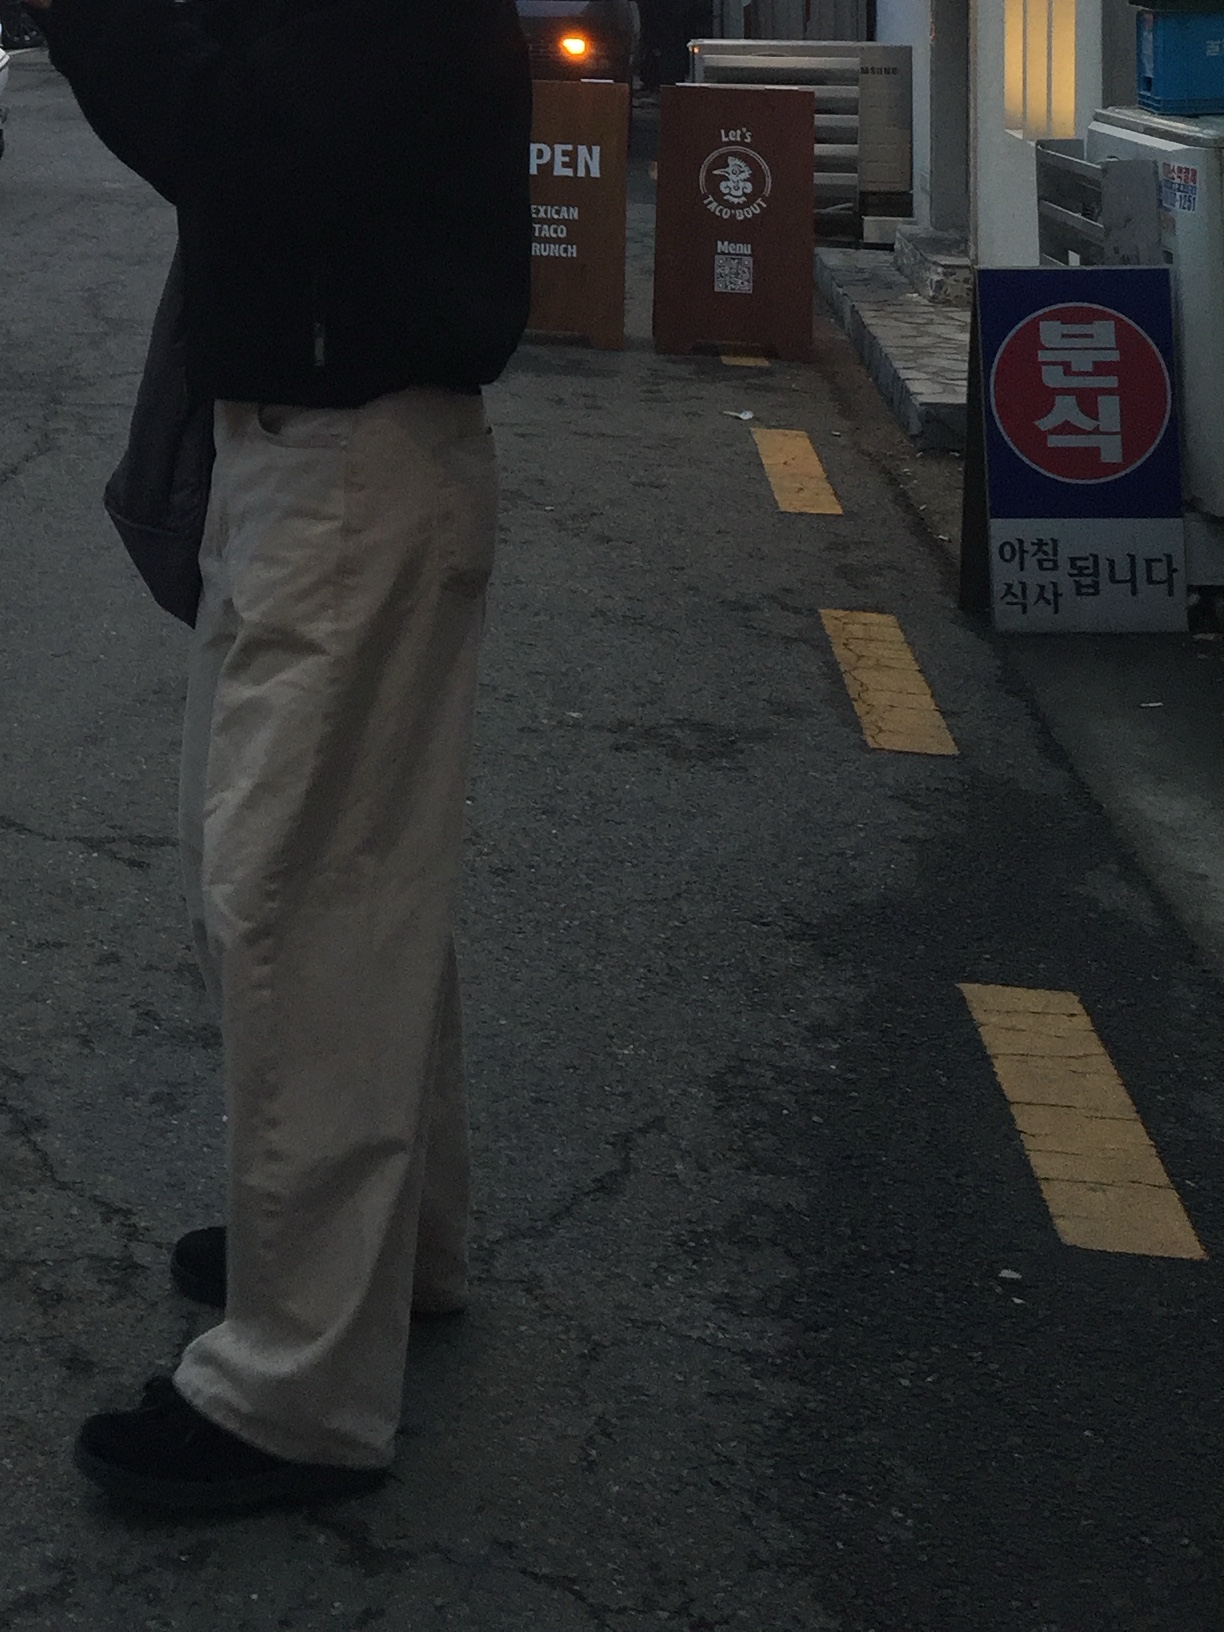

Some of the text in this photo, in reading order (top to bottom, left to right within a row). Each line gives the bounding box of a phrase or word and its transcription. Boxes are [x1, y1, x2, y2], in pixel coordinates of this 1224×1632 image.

[720, 127, 752, 143] Let's
[529, 142, 601, 178] PEN
[530, 204, 578, 220] EXICAN
[532, 223, 567, 238] TACO
[531, 242, 577, 258] RUNCH
[716, 240, 752, 255] Menu
[1033, 320, 1123, 463] 분식
[998, 537, 1060, 572] 아침
[1067, 552, 1178, 597] 됩니다
[1000, 581, 1063, 615] 식사
